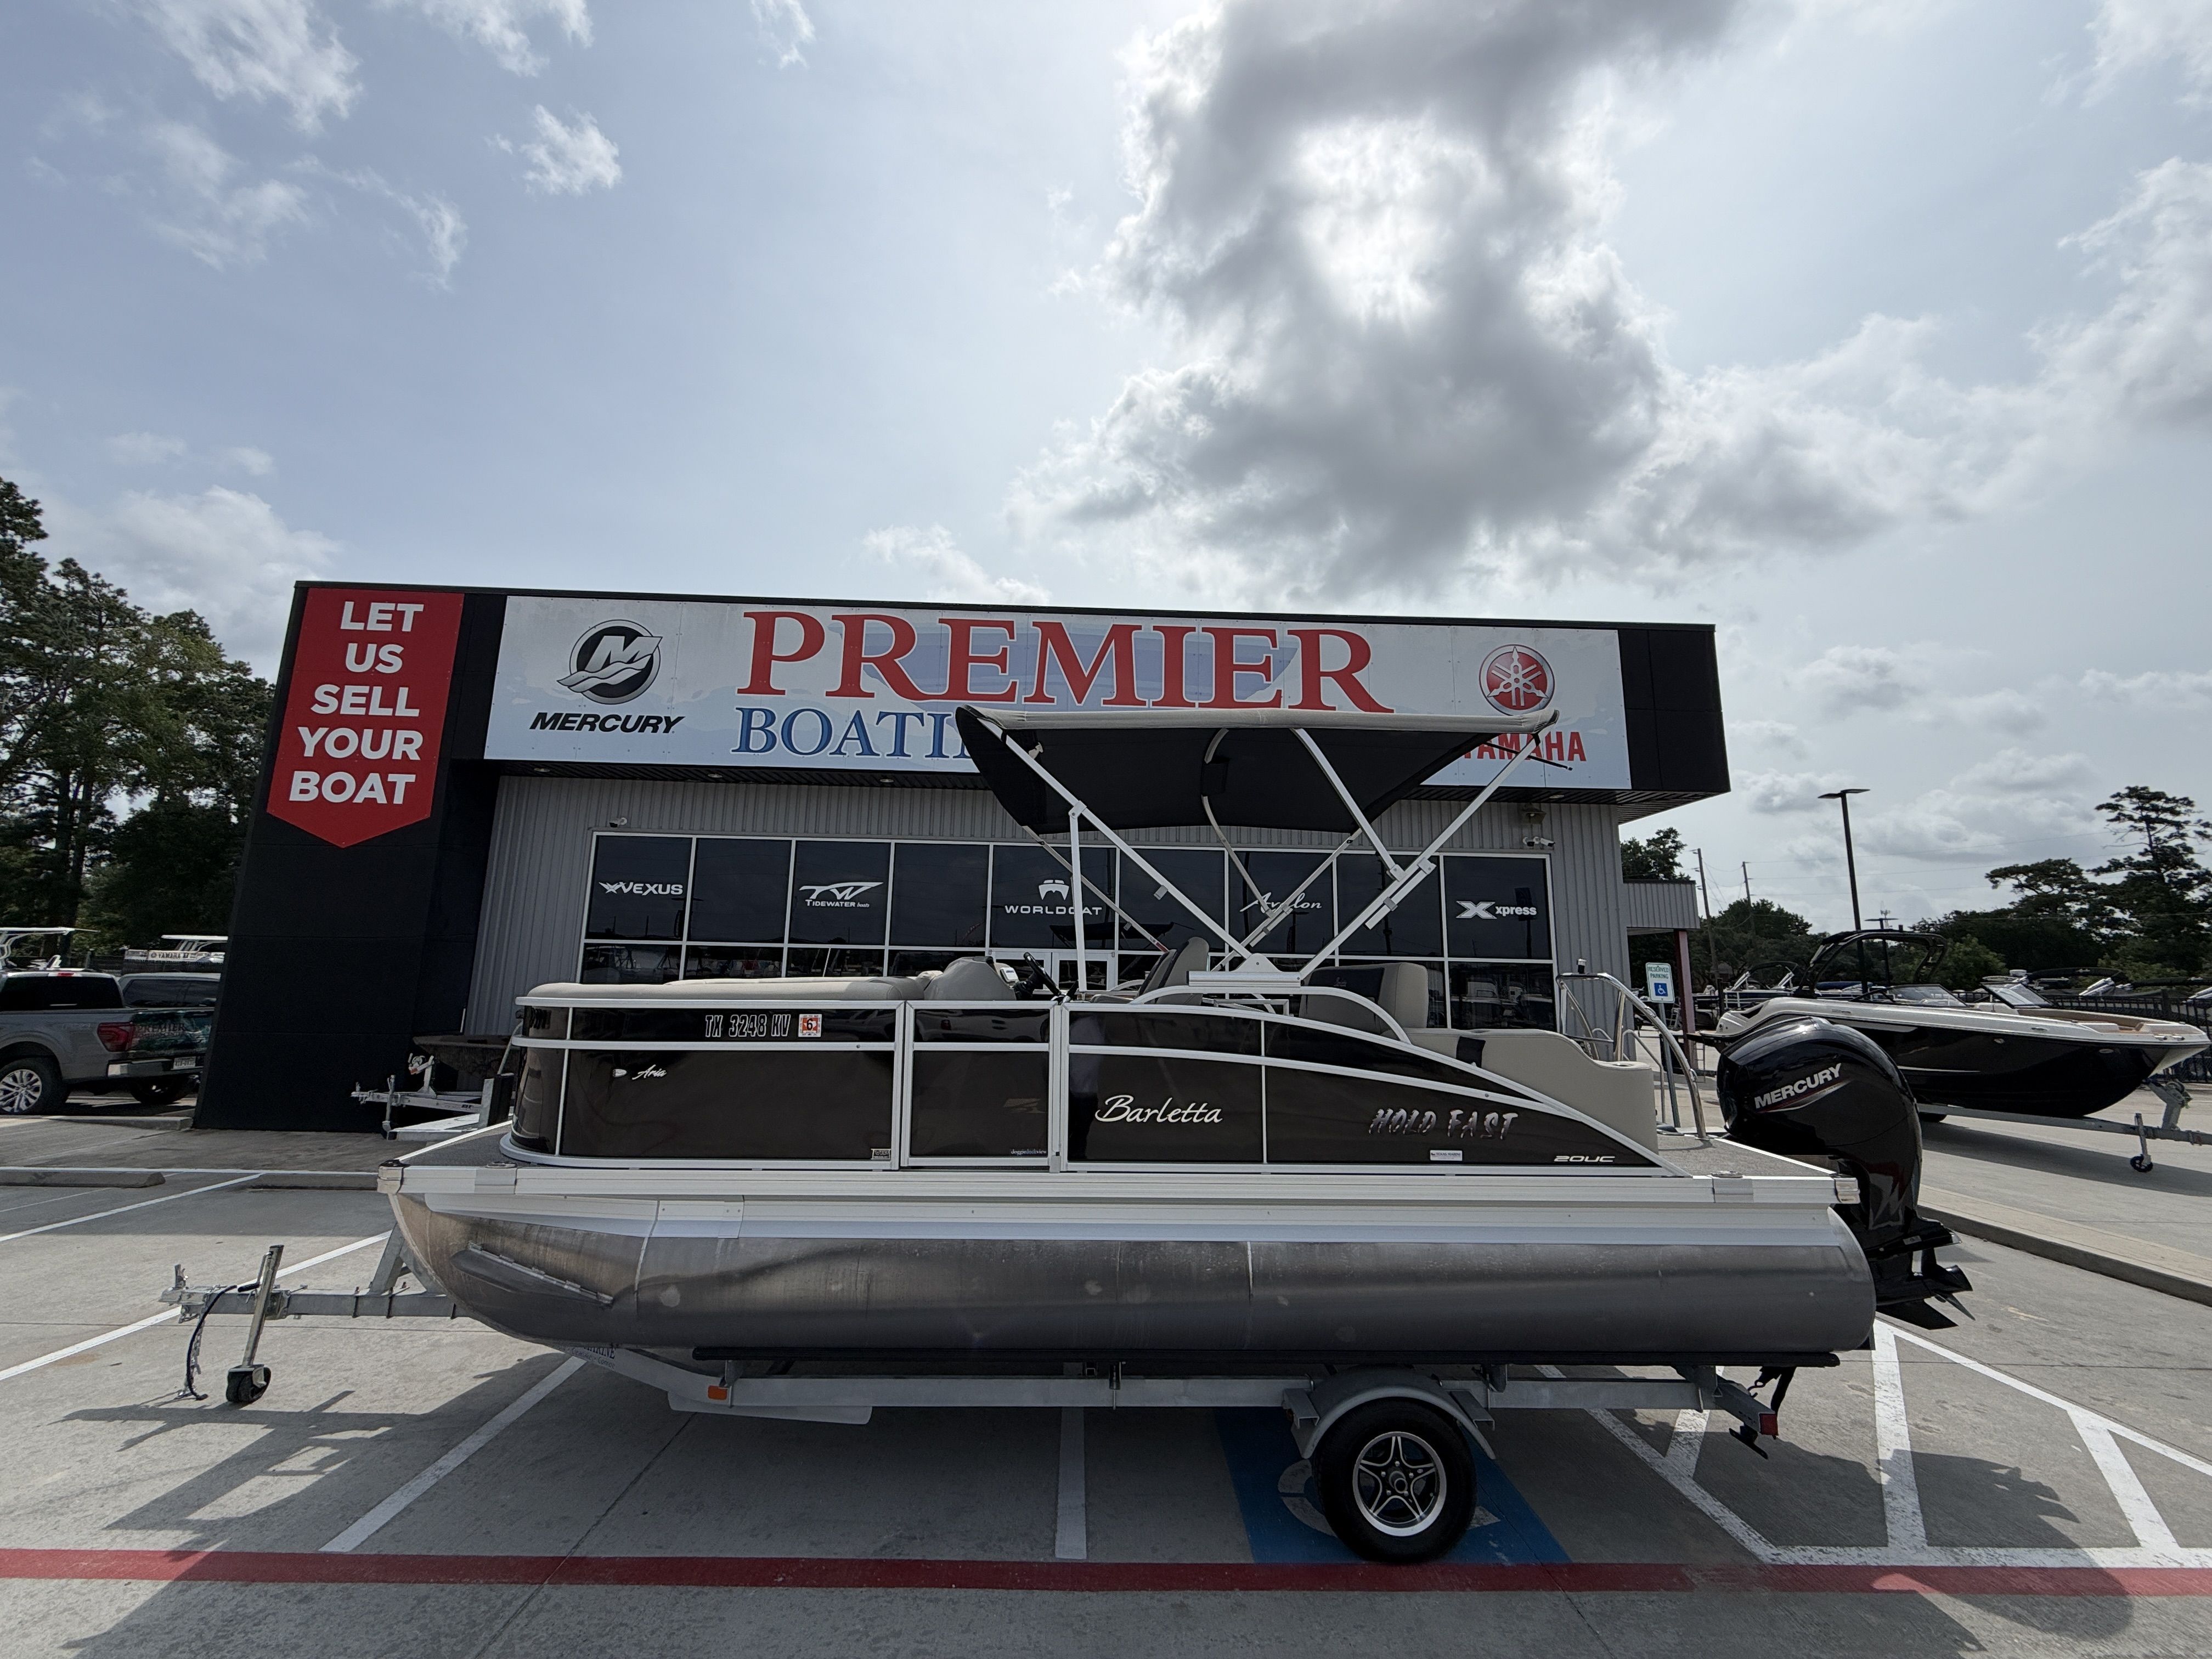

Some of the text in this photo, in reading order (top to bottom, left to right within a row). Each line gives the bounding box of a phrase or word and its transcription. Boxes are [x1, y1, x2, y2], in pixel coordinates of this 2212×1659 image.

[340, 601, 424, 632] LET
[345, 643, 404, 674] US
[736, 611, 1395, 713] PREMIER
[311, 684, 420, 717] SELL
[529, 712, 686, 734] MERCURY
[731, 707, 972, 759] BOATI
[297, 727, 424, 761] YOUR
[289, 771, 416, 805] BOAT
[619, 882, 683, 896] VEXUS
[805, 899, 856, 907] TIDEWATER
[1239, 892, 1322, 913] Avlon
[1495, 906, 1537, 917] xpress
[705, 1014, 791, 1037] TX 3248 KV
[806, 1018, 813, 1031] 6
[631, 1064, 667, 1080] Aria
[1754, 1063, 1842, 1109] MERCURY
[1094, 1094, 1223, 1123] Barletta
[1368, 1108, 1519, 1140] HOLD FAST
